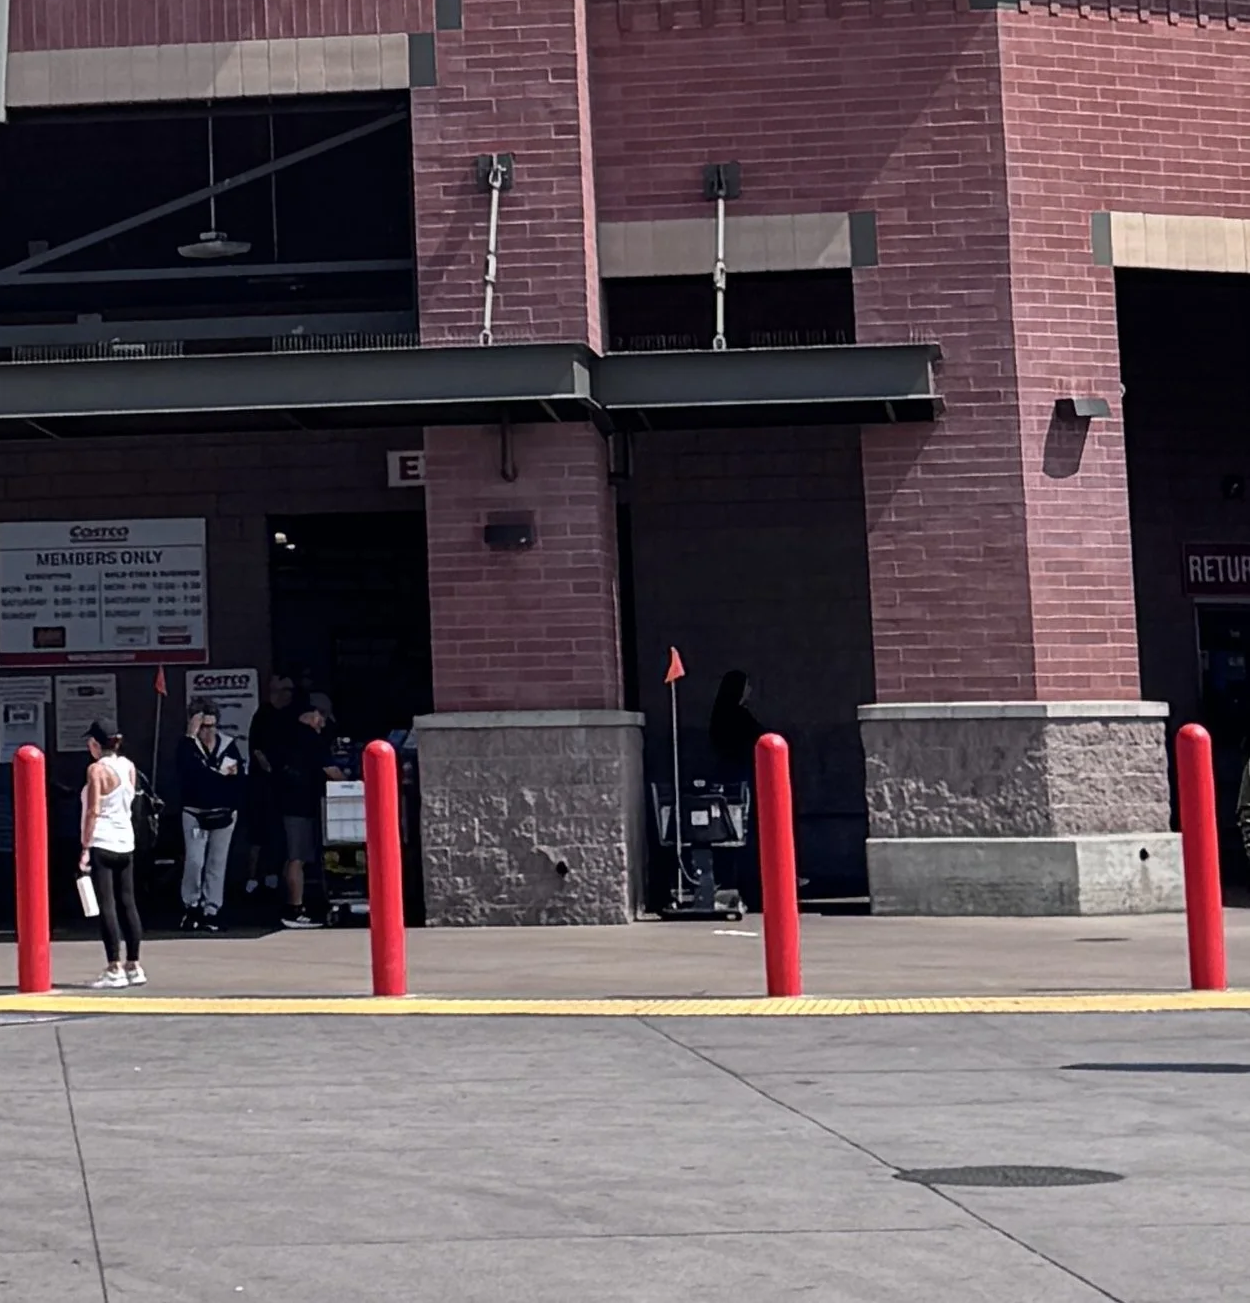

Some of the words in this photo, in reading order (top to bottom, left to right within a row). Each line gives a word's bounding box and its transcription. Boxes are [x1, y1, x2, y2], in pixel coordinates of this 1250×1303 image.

[399, 455, 425, 481] E
[36, 550, 117, 566] MEMBERS
[120, 549, 163, 565] ONLY
[193, 673, 250, 686] COSTCO
